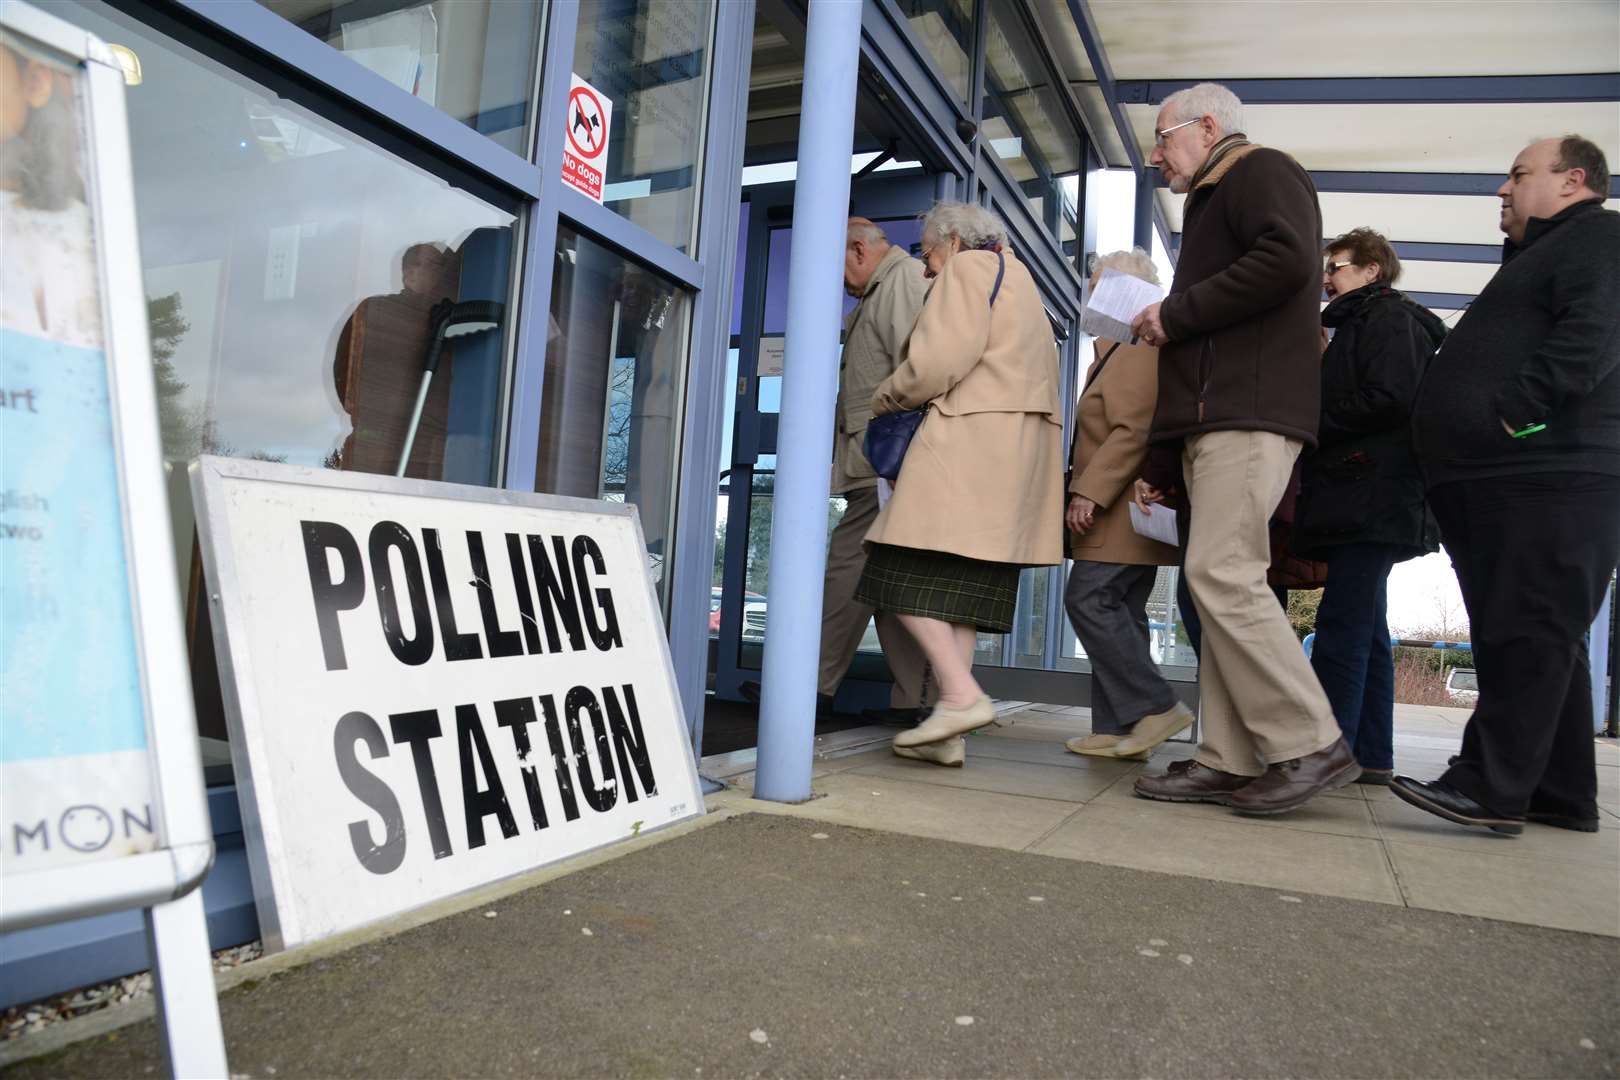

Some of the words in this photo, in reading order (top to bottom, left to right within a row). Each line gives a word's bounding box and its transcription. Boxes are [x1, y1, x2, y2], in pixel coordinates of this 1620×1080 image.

[562, 151, 576, 170] No
[577, 163, 600, 185] dogs
[589, 186, 600, 198] dogs
[300, 520, 623, 671] POLLING
[334, 685, 658, 874] STATION
